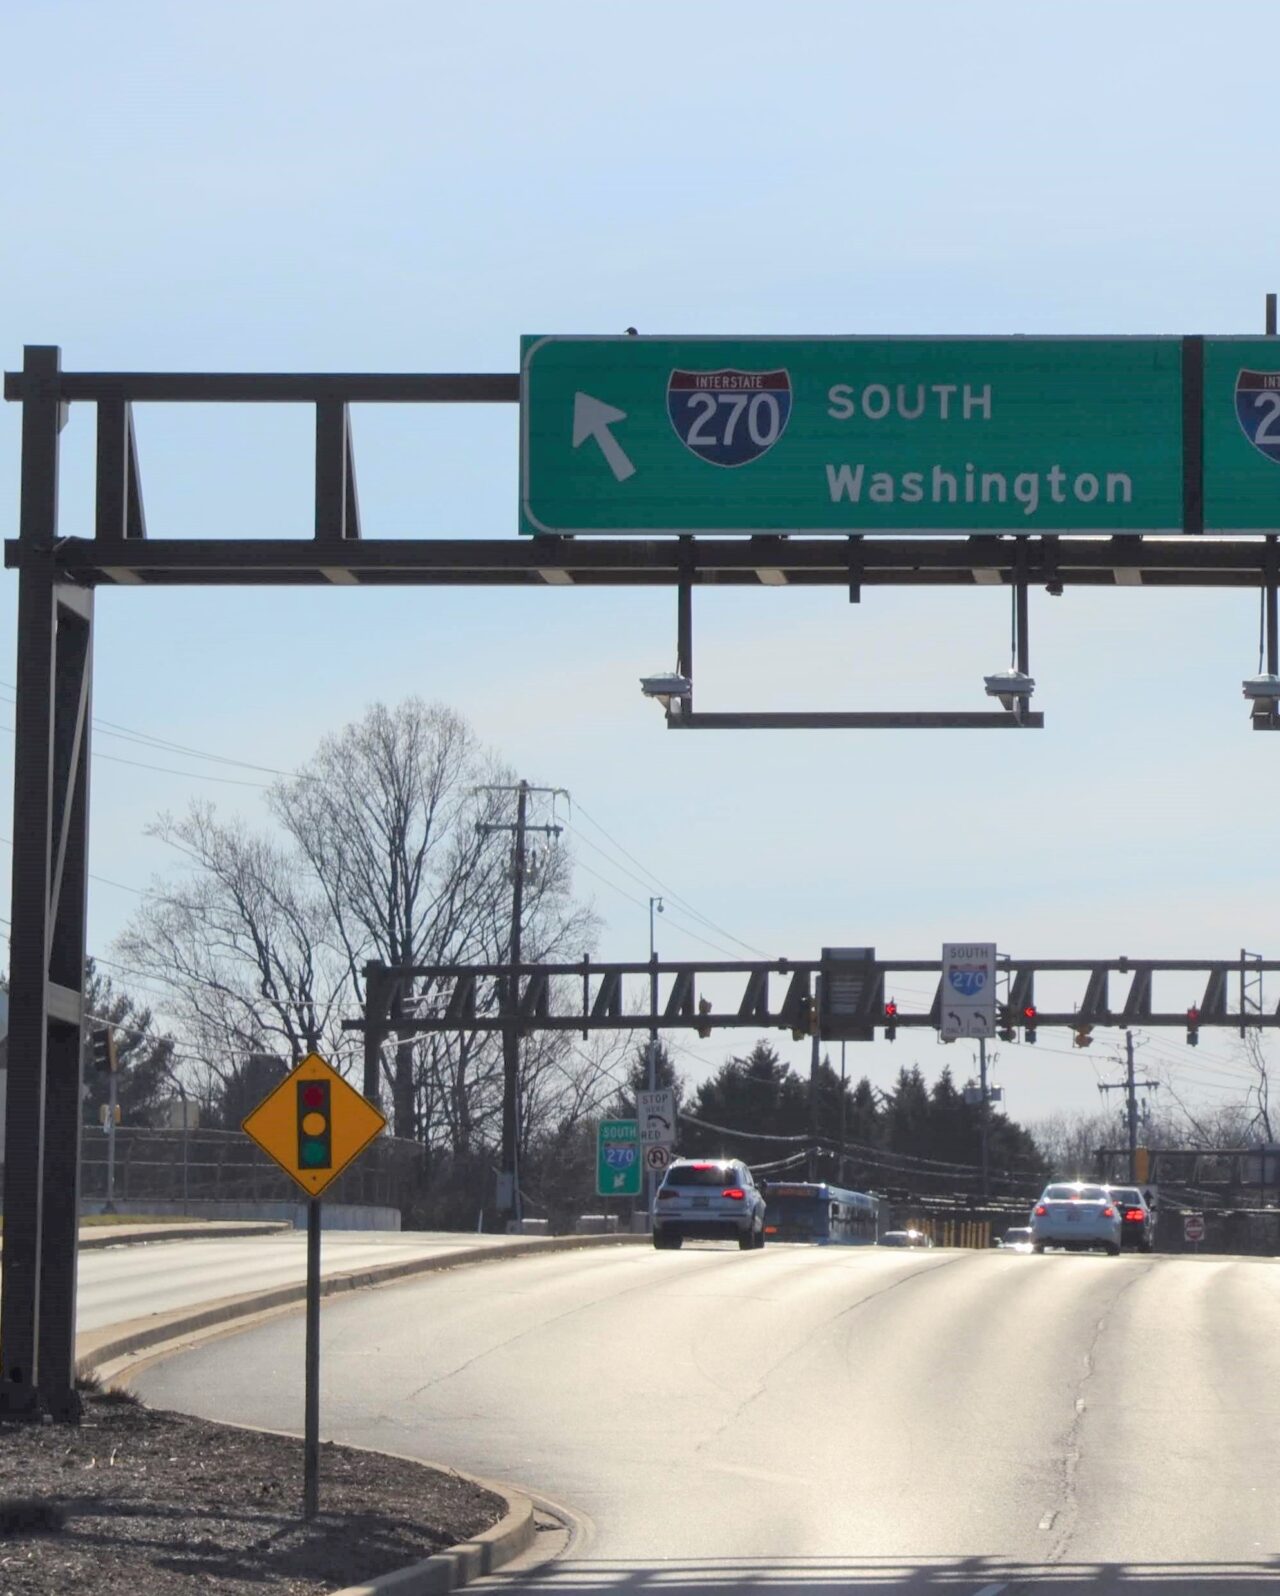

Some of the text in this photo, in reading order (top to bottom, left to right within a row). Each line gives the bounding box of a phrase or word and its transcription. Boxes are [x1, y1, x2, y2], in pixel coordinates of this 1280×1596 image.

[696, 376, 763, 388] INTERSTATE
[827, 384, 992, 419] SOUTH
[687, 392, 780, 446] 270
[825, 463, 1132, 515] Washington
[951, 947, 988, 959] SOUTH
[953, 972, 986, 988] 270
[642, 1093, 668, 1105] STOP
[603, 1126, 637, 1139] SOUTH
[607, 1149, 634, 1163] 270
